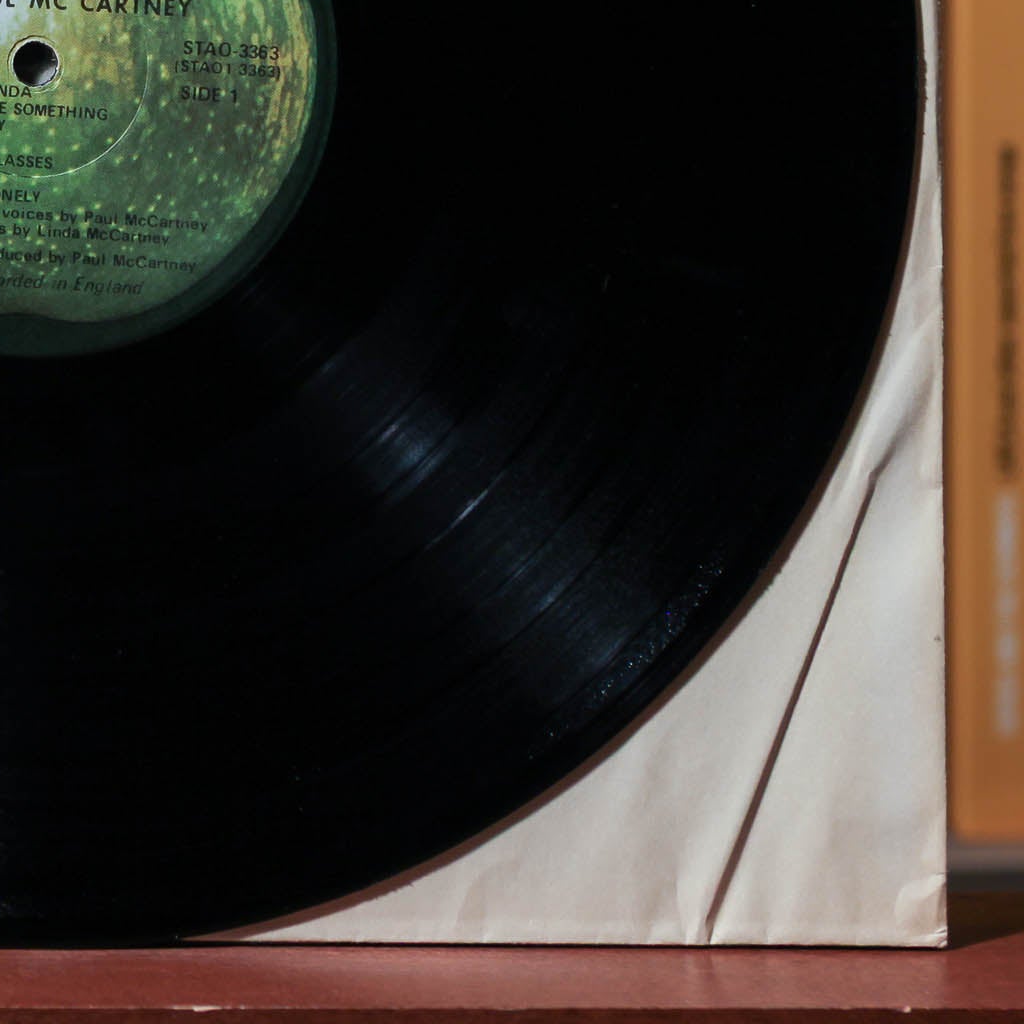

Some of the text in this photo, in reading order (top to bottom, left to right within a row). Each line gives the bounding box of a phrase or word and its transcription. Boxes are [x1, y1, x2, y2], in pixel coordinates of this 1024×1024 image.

[181, 85, 238, 103] SIDE 1
[13, 102, 108, 121] SOMETHING
[2, 208, 53, 222] voices
[60, 210, 77, 224] by
[84, 211, 118, 225] Paul
[126, 213, 208, 233] McCartney
[12, 223, 30, 237] by
[37, 225, 81, 239] Linda
[86, 228, 170, 246] McCartney
[48, 250, 66, 266] by
[72, 251, 106, 266] Paul
[113, 254, 197, 273] McCartney
[51, 278, 67, 289] in
[72, 276, 145, 296] England
